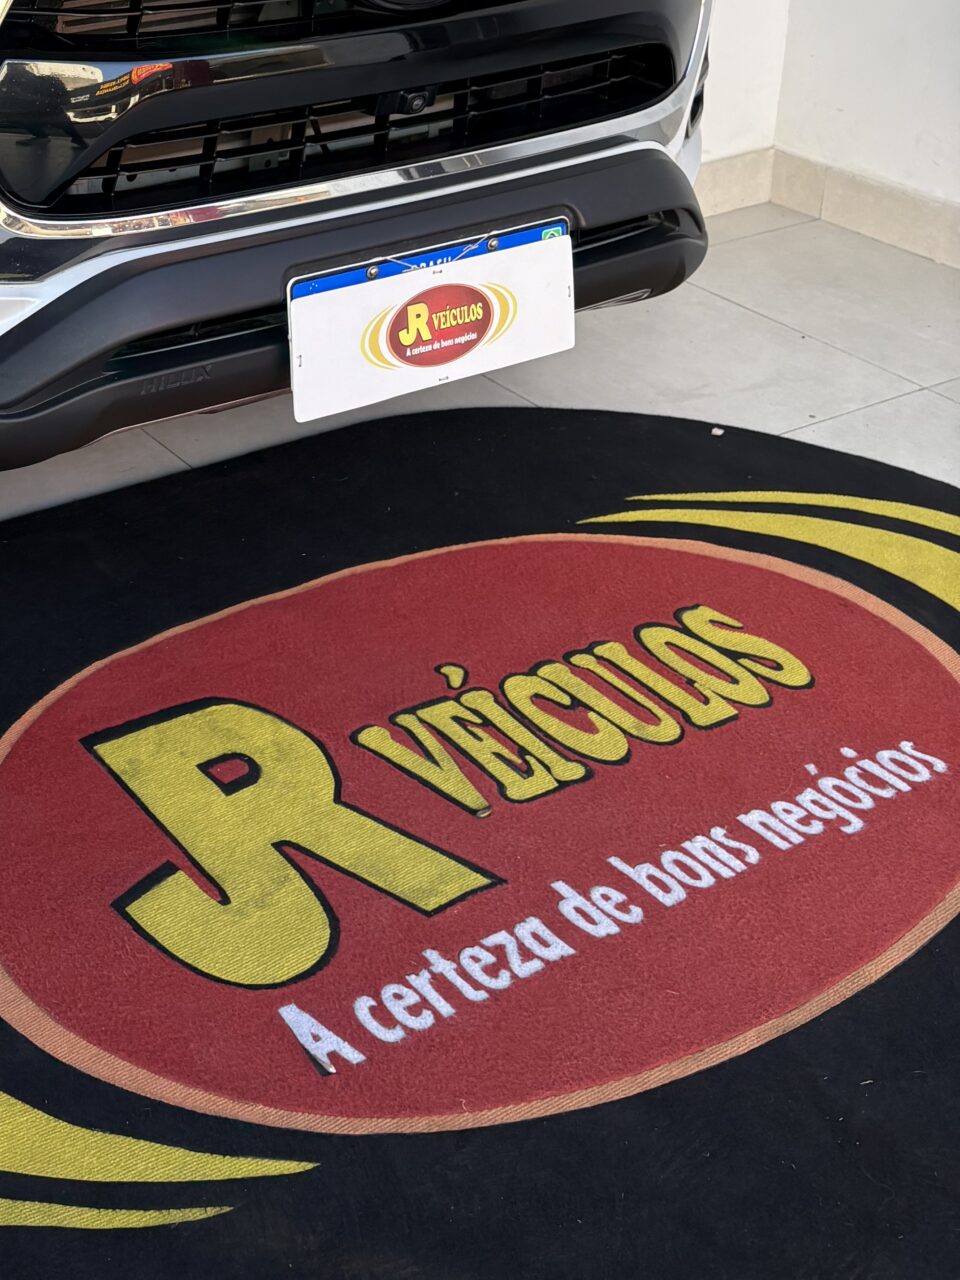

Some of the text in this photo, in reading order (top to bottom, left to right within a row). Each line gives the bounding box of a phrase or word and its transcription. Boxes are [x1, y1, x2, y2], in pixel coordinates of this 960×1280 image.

[398, 301, 483, 346] JR VEÍCULOS
[406, 347, 412, 357] A
[141, 364, 213, 395] HILUX
[81, 604, 815, 990] JR VEÍCULOS
[277, 740, 948, 1076] A certeza de bons negócios
